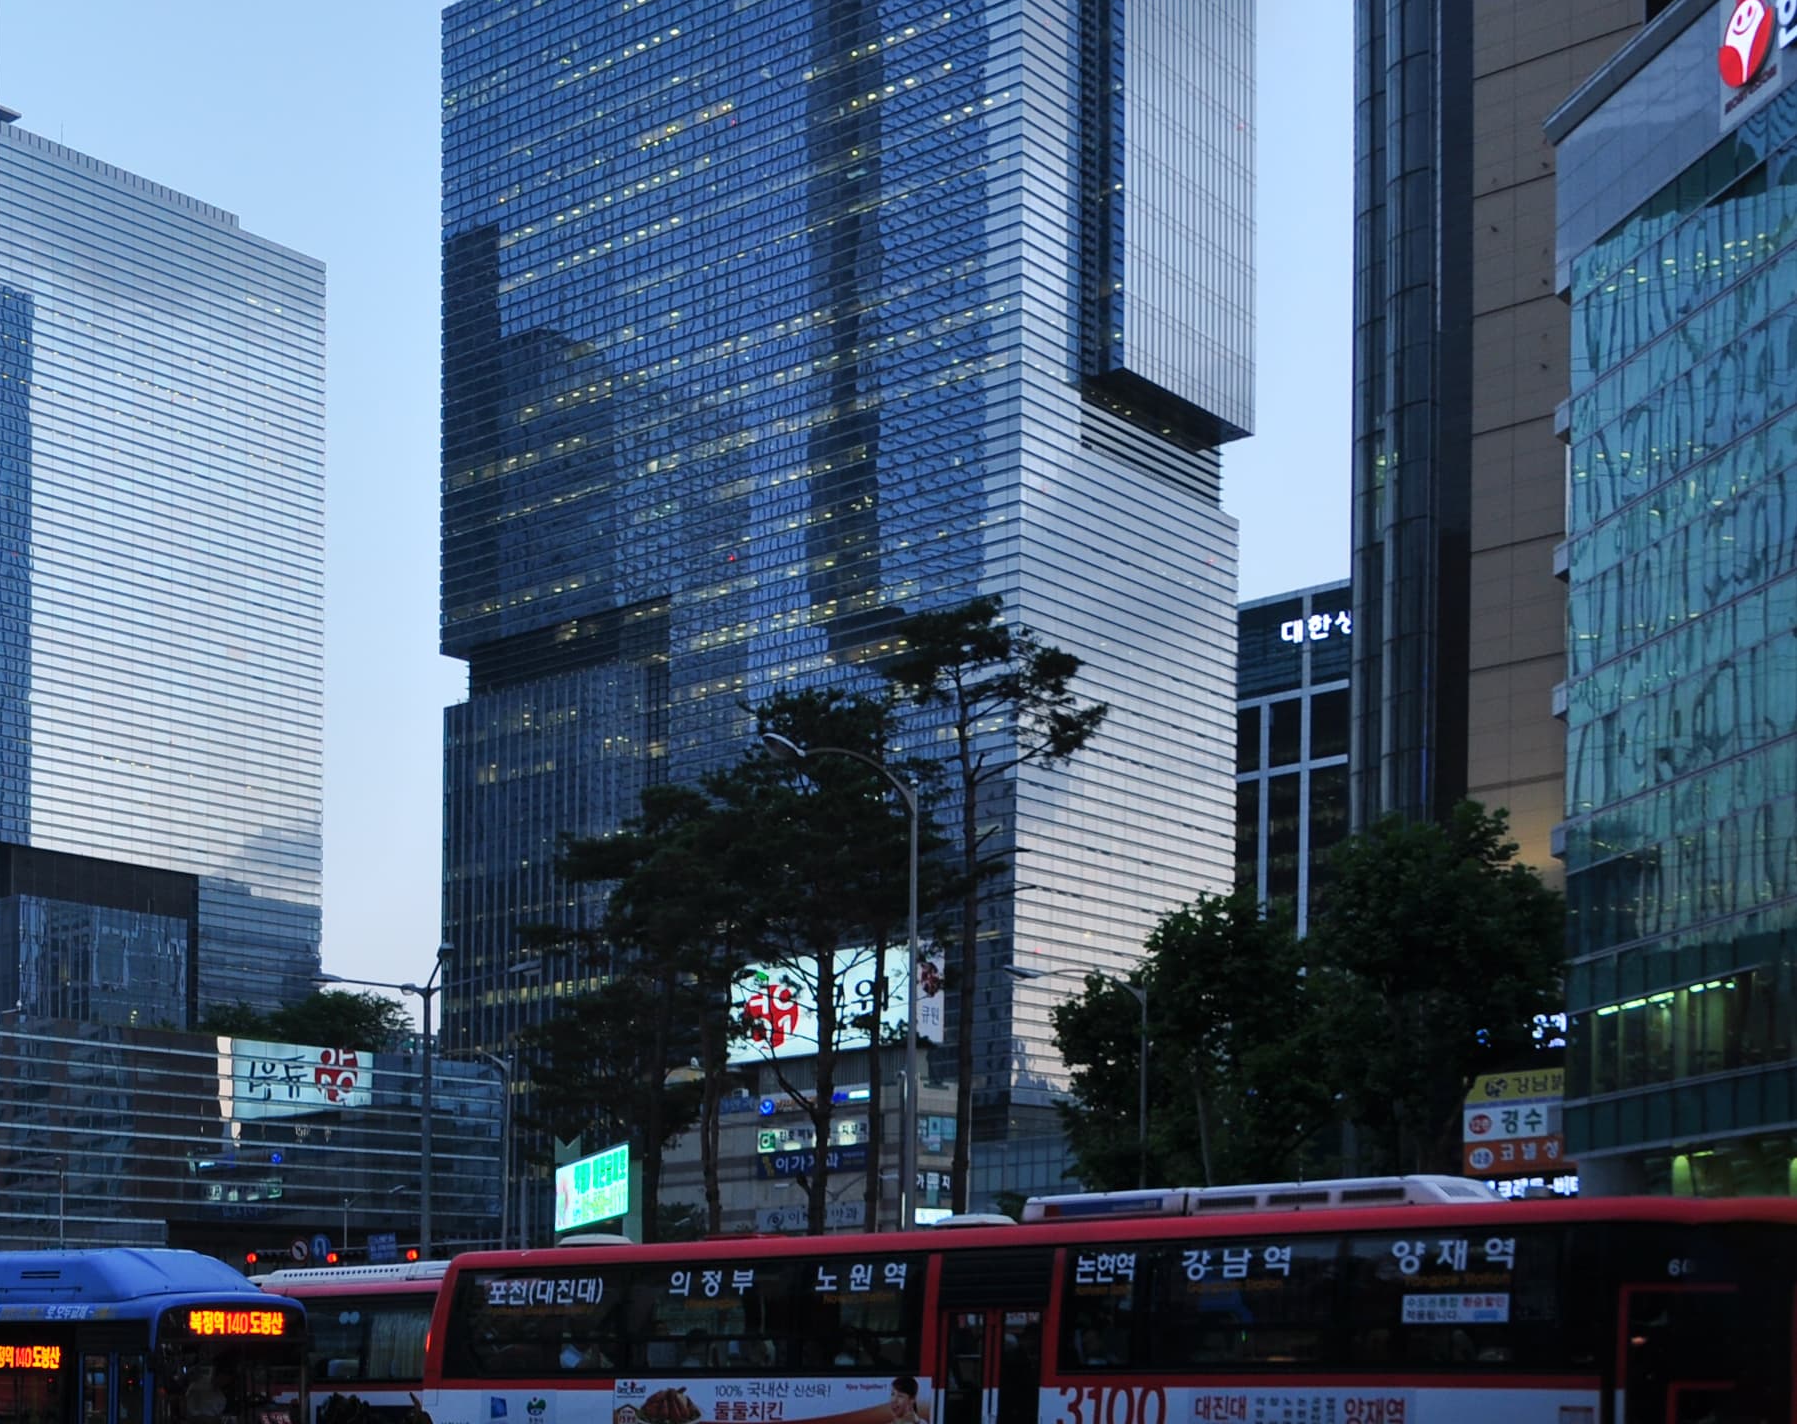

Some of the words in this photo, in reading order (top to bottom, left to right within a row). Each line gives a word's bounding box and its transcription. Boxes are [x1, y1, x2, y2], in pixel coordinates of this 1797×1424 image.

[1501, 1108, 1543, 1134] 경수
[487, 1276, 604, 1306] 포천(대진대)
[668, 1269, 755, 1298] 의정부
[814, 1261, 907, 1293] 노원역
[1075, 1252, 1136, 1286] 논현역
[1182, 1245, 1292, 1283] 강남역
[1392, 1238, 1516, 1275] 양재역
[226, 1312, 248, 1334] 140
[249, 1311, 284, 1335] 도봉산
[15, 1346, 32, 1368] 140
[32, 1345, 61, 1369] 도봉산
[714, 1385, 744, 1398] 100%
[746, 1381, 789, 1398] 국내산
[713, 1401, 783, 1421] 둘둘치킨
[1056, 1387, 1167, 1424] 3100
[1194, 1396, 1248, 1420] 대진대
